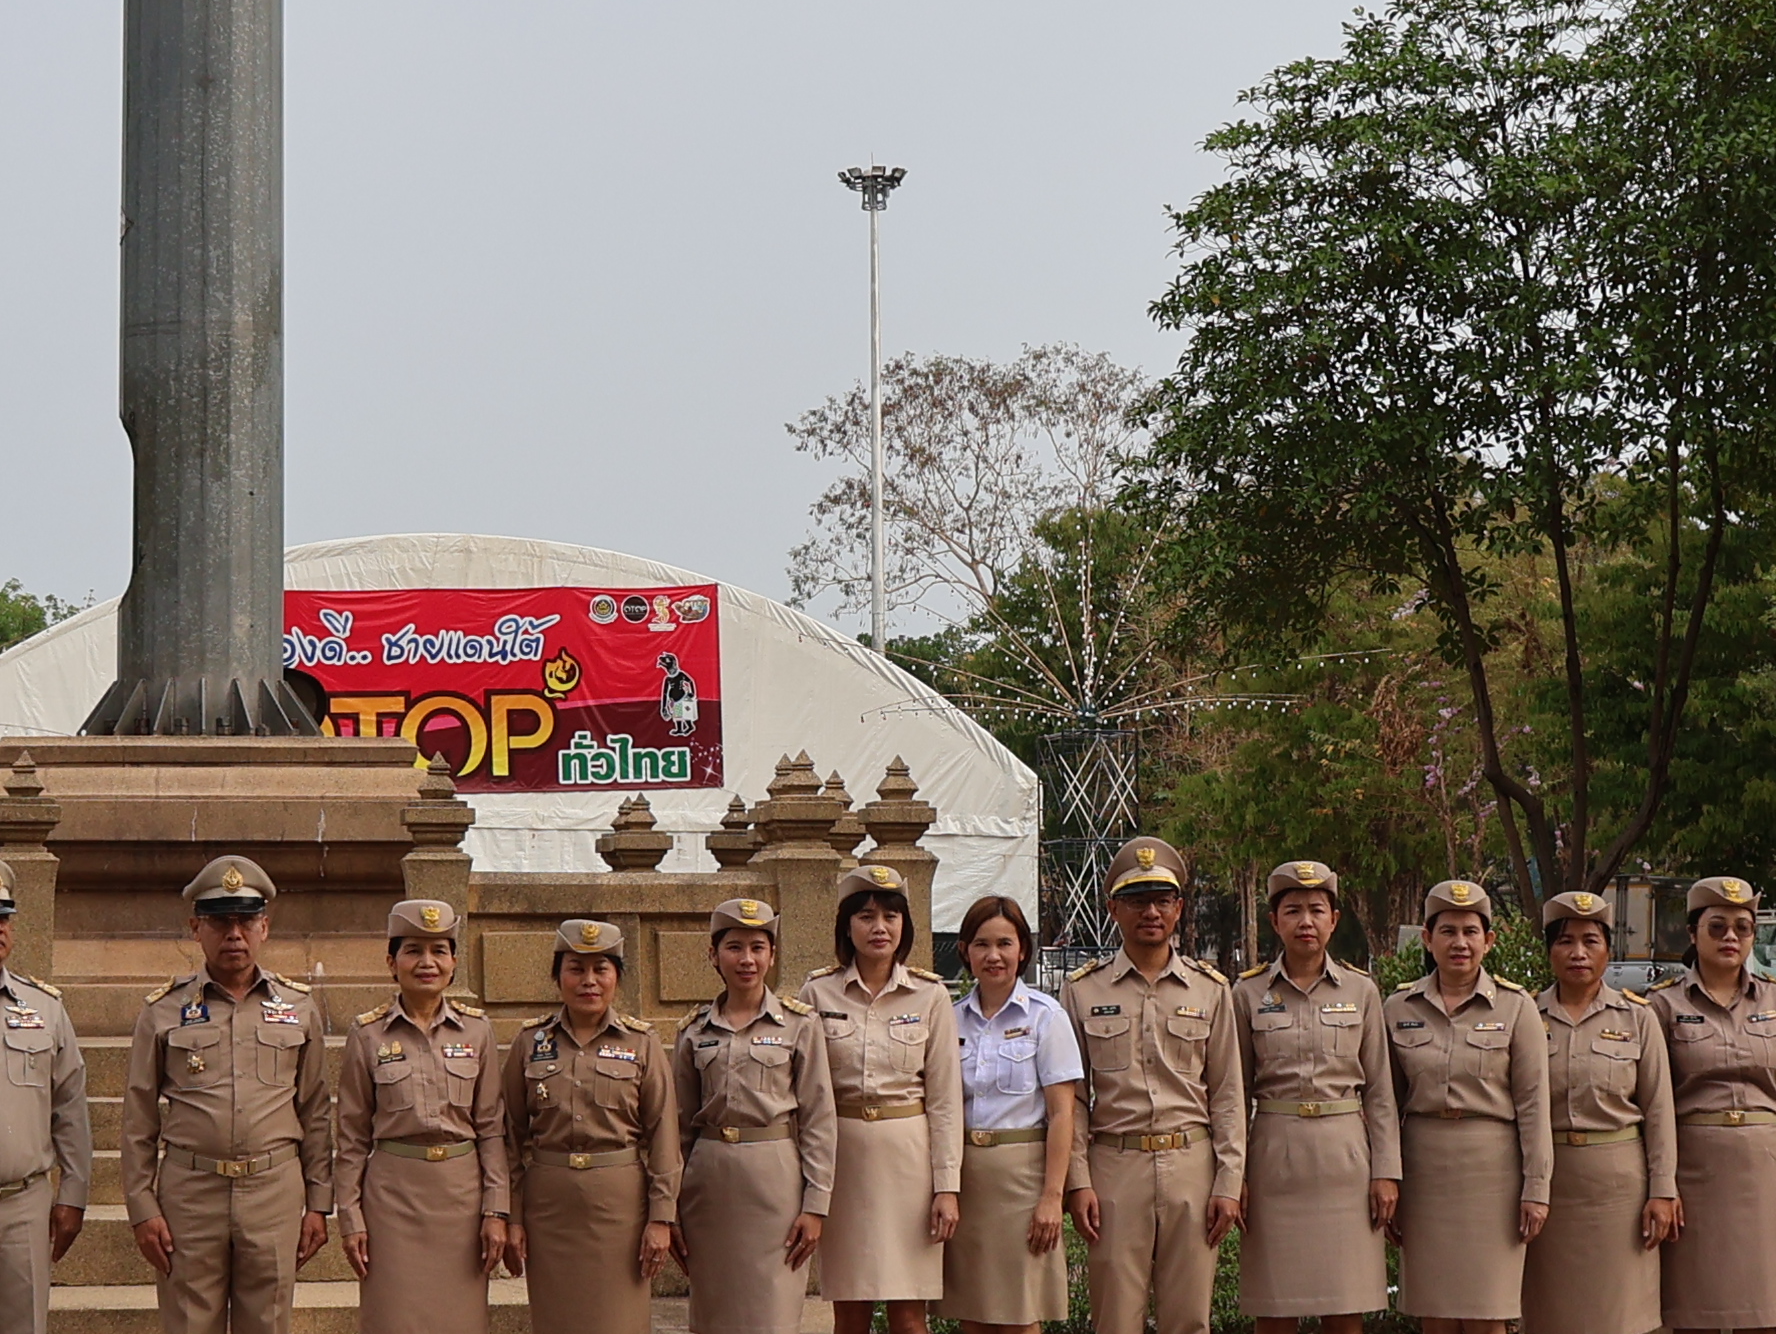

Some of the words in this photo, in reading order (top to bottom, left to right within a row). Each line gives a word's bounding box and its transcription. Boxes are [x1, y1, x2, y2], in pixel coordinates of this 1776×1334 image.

[283, 609, 373, 667] องดี..
[320, 694, 555, 777] TOP
[559, 730, 691, 784] ทั่วไทย
